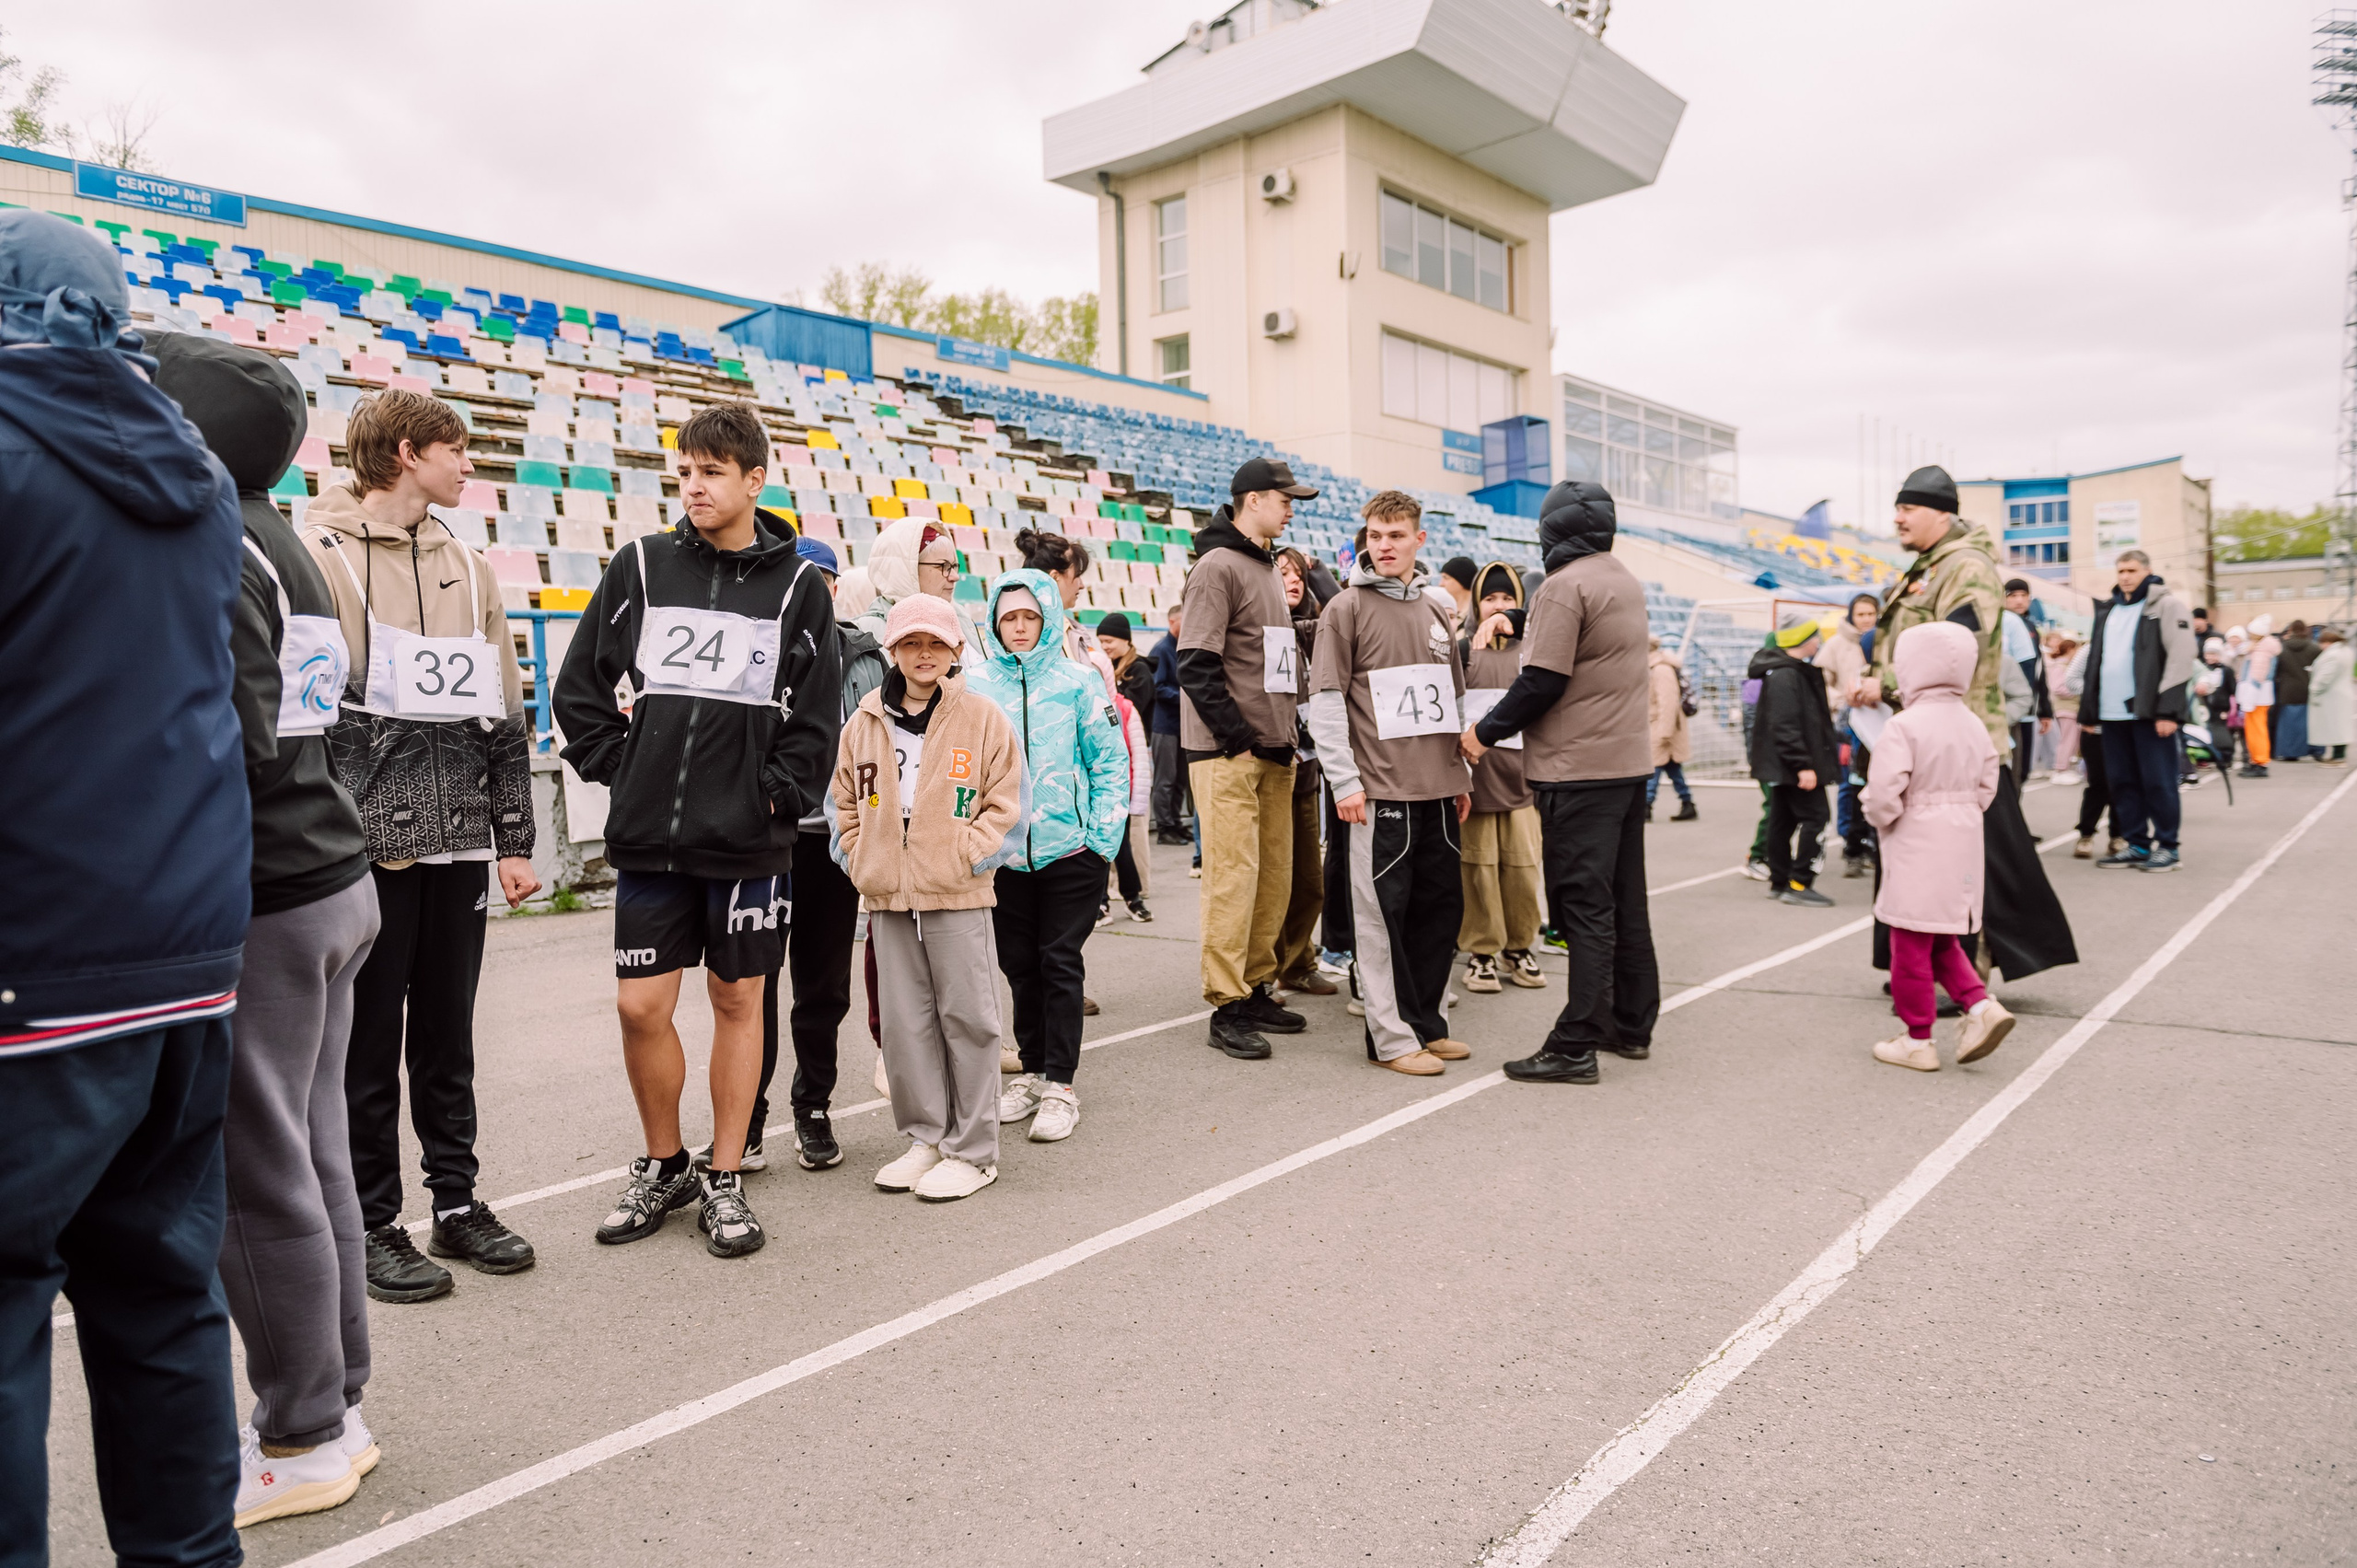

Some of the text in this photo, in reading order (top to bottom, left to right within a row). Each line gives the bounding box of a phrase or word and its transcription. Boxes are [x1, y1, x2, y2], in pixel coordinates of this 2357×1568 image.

[115, 175, 180, 197] СЕКТОР
[191, 203, 212, 215] 570
[661, 625, 725, 672] 24
[414, 650, 477, 697] 32
[1396, 684, 1444, 724] 43
[947, 748, 972, 779] B
[856, 762, 878, 801] R
[391, 810, 414, 821] NIKE
[502, 812, 523, 823] NIKE
[954, 785, 977, 819] K
[260, 1471, 274, 1486] G
